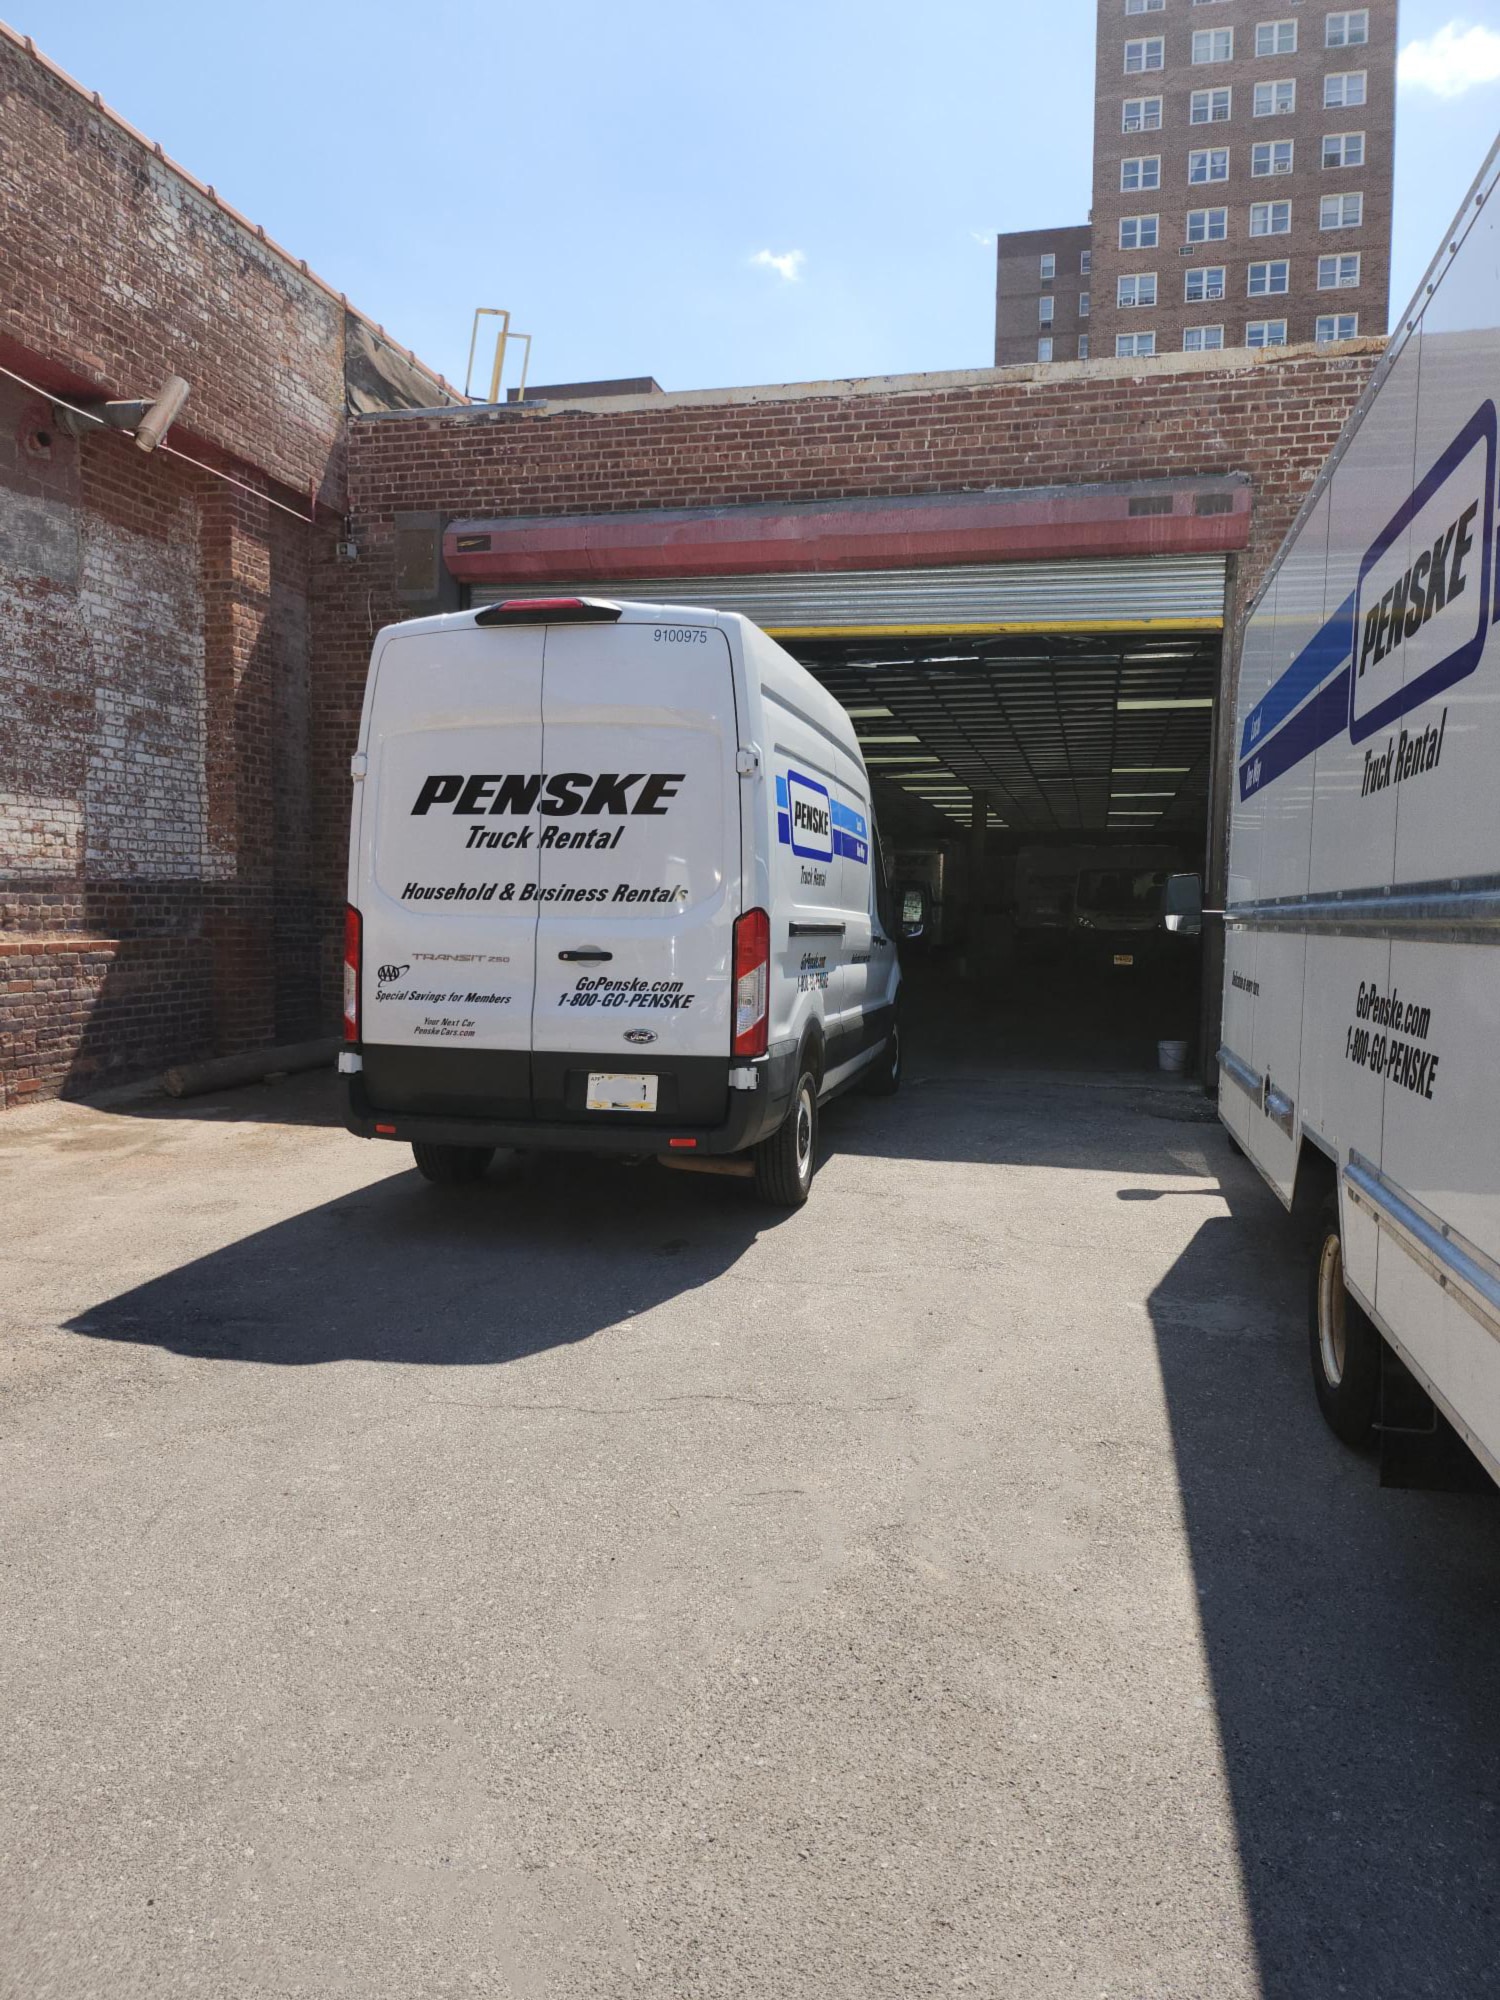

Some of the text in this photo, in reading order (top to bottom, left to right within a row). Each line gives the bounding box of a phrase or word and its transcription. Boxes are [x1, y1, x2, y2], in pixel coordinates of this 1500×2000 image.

[1358, 498, 1479, 679] PENSKE
[653, 630, 707, 644] 9100975
[1361, 707, 1447, 798] Truck Rental
[410, 772, 687, 816] PENSKE
[794, 800, 828, 836] PENSKE
[465, 825, 625, 850] Truck Rental
[401, 882, 688, 904] Household & Business Rentals
[412, 953, 486, 962] TRANSIT
[576, 976, 684, 993] GoPenske.com
[375, 990, 512, 1004] Special Savings for Members
[558, 993, 696, 1009] 1-800-GO-PENSKE
[1356, 981, 1431, 1040] GoPenske.com
[424, 1017, 476, 1028] Your Next Car
[1345, 1025, 1440, 1100] 1-800-GO-PENSKE
